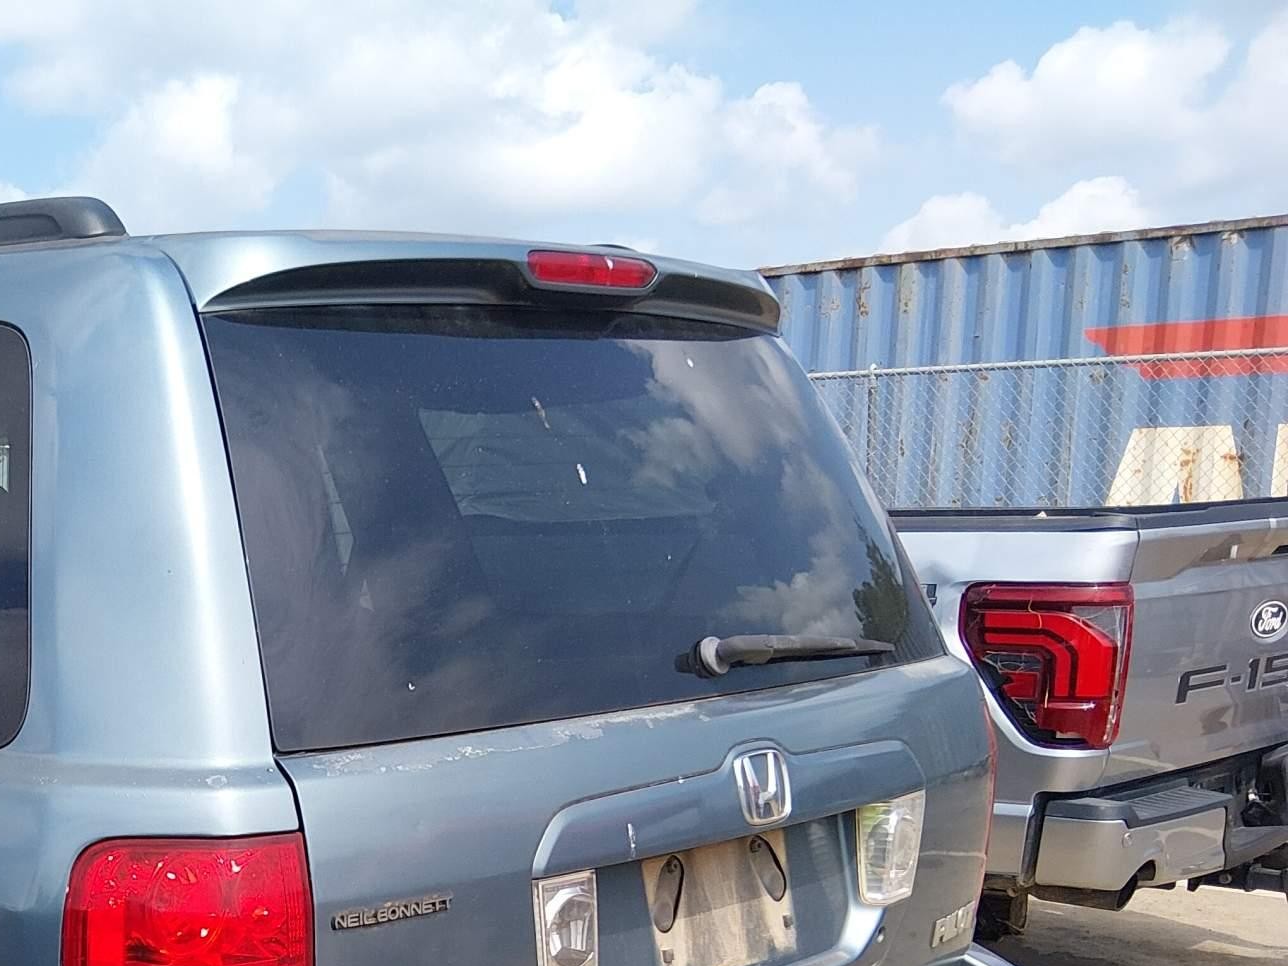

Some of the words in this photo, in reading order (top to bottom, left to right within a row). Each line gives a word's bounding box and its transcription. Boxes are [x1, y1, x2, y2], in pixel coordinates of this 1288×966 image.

[1257, 606, 1283, 633] Ford
[334, 910, 376, 929] NEIL
[377, 896, 453, 923] BONNETT
